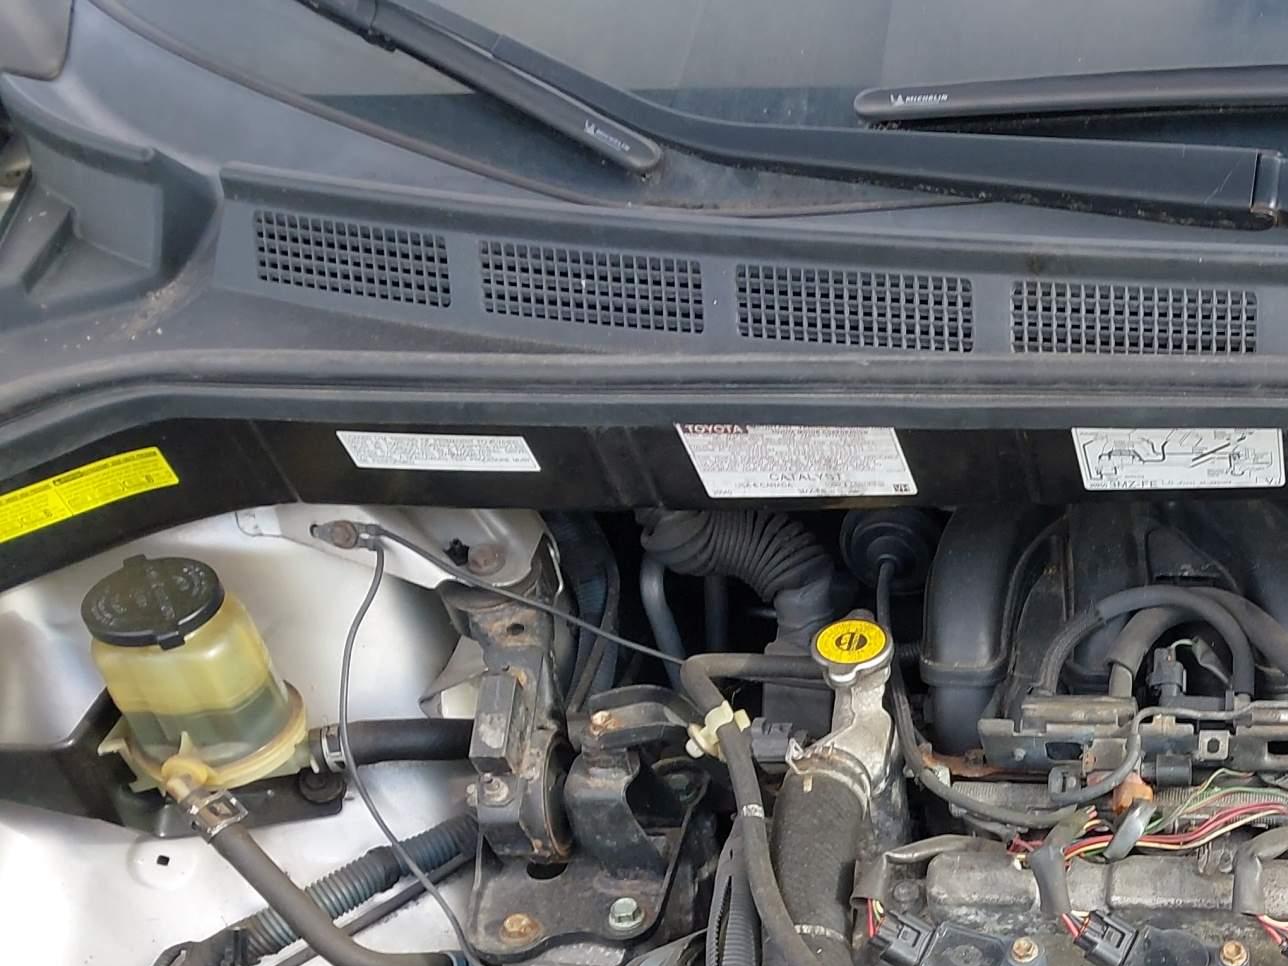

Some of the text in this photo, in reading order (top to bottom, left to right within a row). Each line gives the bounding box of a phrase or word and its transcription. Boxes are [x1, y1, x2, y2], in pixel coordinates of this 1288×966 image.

[905, 94, 949, 104] MICHELIN
[685, 424, 743, 434] TOYOTA
[769, 473, 843, 482] CATALYST
